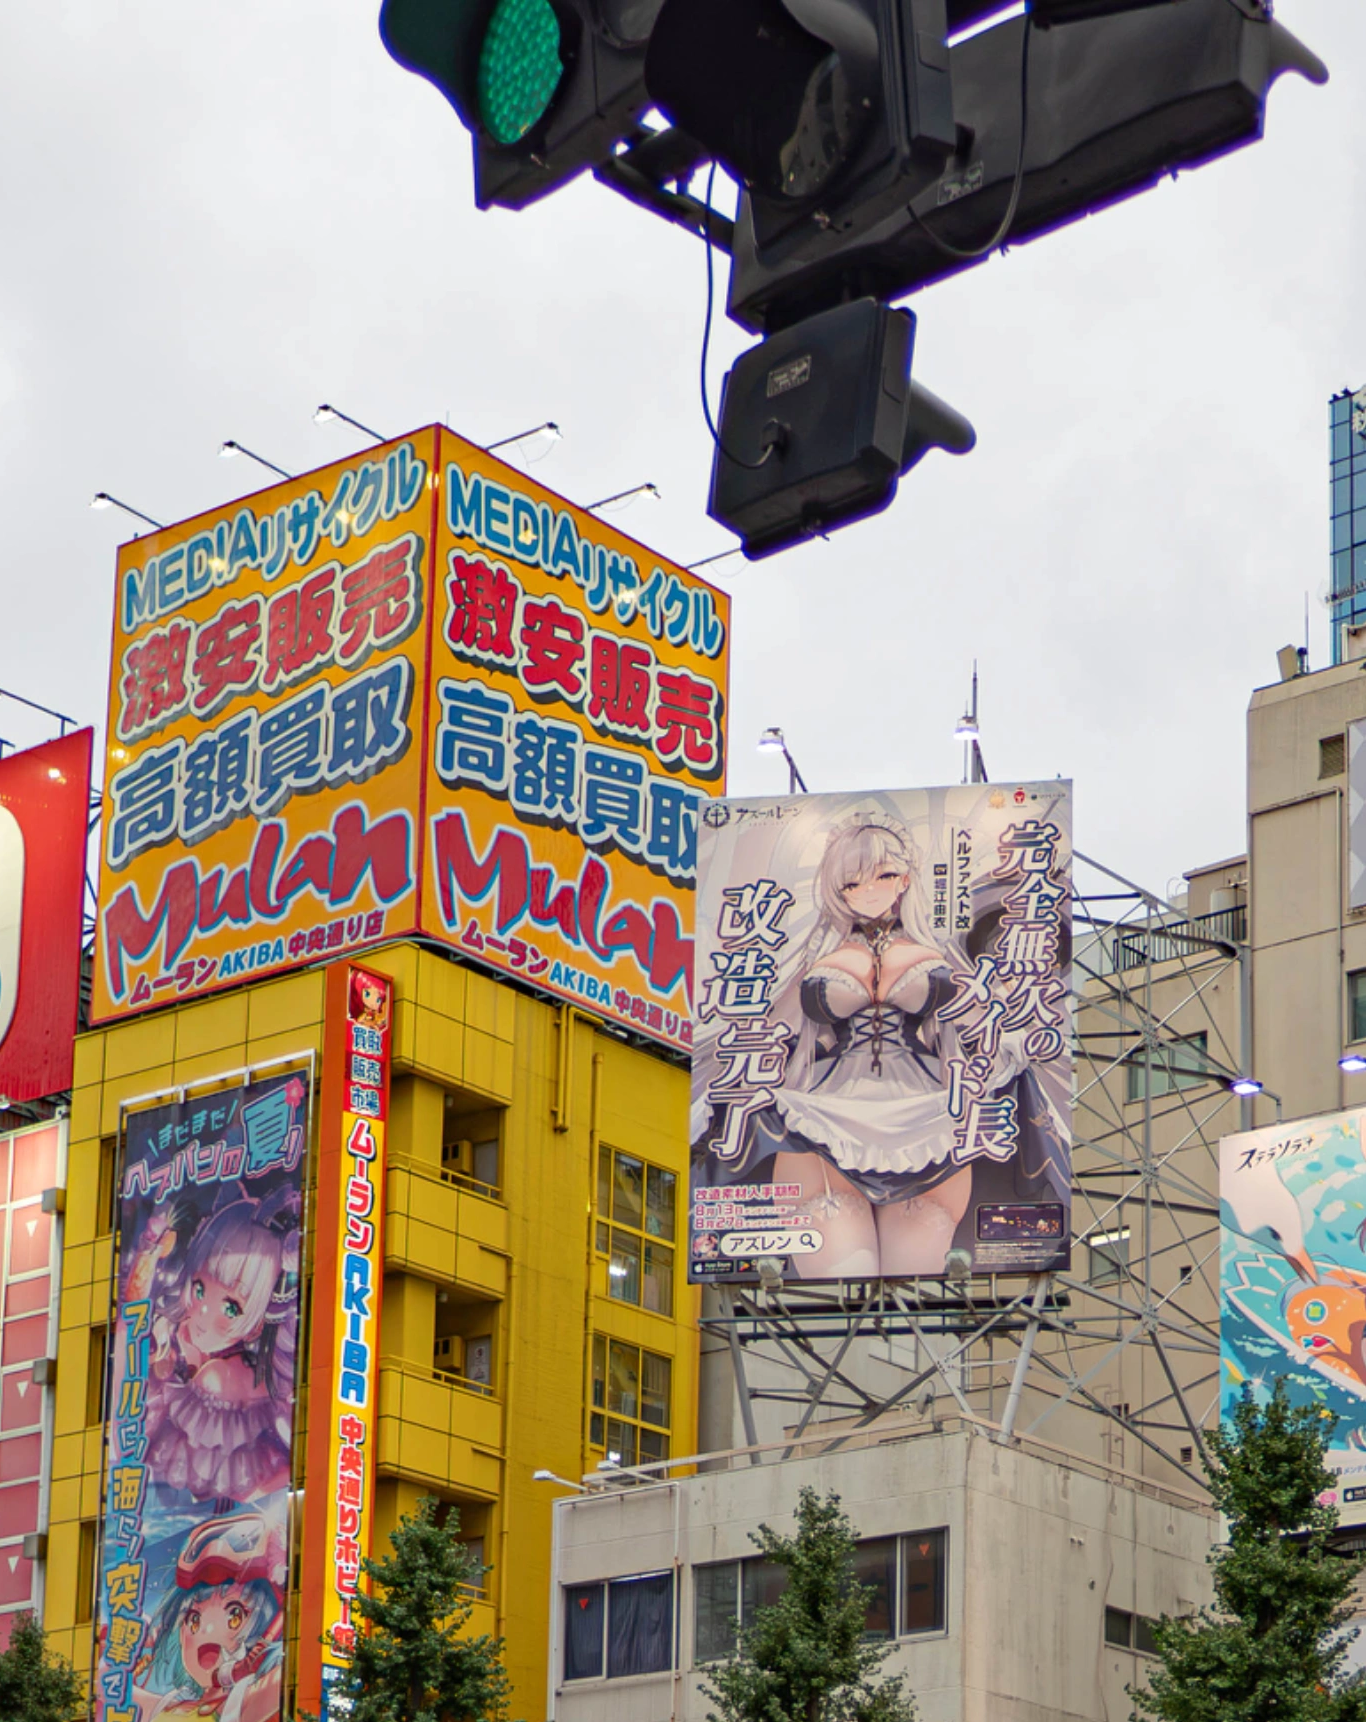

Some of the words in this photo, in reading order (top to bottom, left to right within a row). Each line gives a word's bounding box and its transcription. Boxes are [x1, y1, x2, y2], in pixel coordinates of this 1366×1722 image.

[124, 442, 424, 630] MEDIAリサイクル
[447, 463, 724, 657] MEDIAリサイクル
[120, 535, 419, 738] 激安販売
[447, 550, 720, 768] 激安販売
[109, 658, 413, 866] 高額買取
[104, 804, 416, 1002] Mulan
[432, 806, 697, 1012] Mulan
[955, 827, 972, 930] ベルファスト改
[994, 818, 1065, 1065] 完全無欠の
[350, 1087, 380, 1114] 市場
[351, 1057, 381, 1084] 販売
[352, 1023, 382, 1055] 買取
[700, 878, 793, 1161] 改造完了
[937, 956, 1018, 1166] メイド長
[728, 1235, 792, 1252] アズレン
